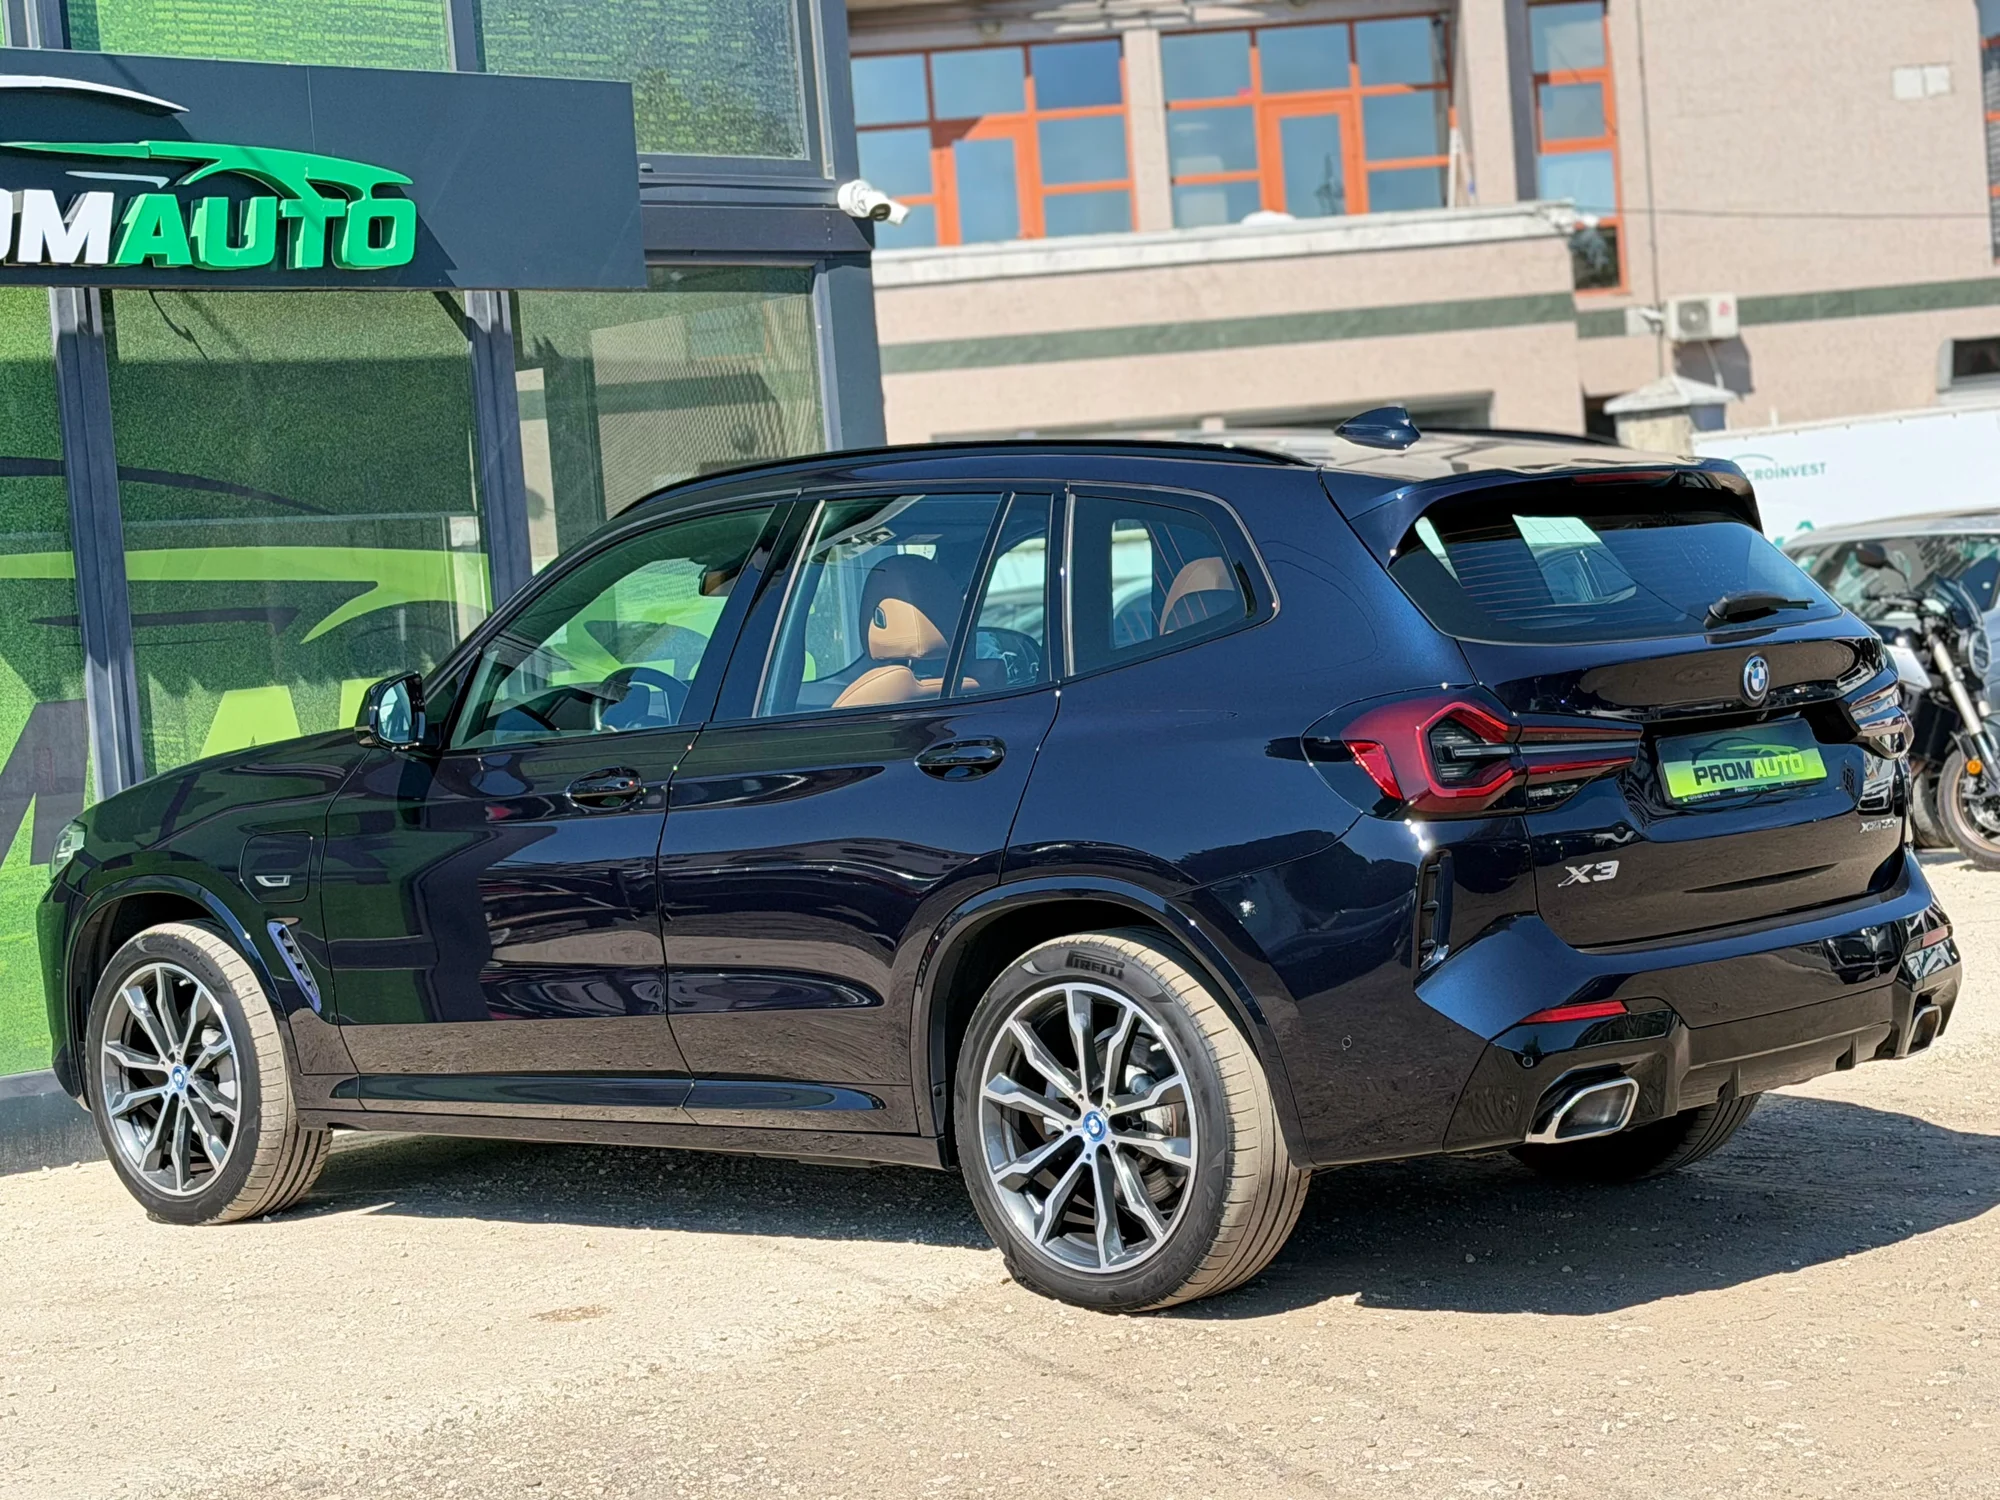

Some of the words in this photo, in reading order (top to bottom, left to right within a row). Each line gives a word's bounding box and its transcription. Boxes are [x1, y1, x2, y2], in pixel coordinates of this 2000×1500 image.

[0, 188, 417, 270] MAUTO
[1693, 753, 1805, 786] PROMAUTO
[1558, 860, 1620, 887] X3
[1065, 950, 1125, 980] PIRELLI
